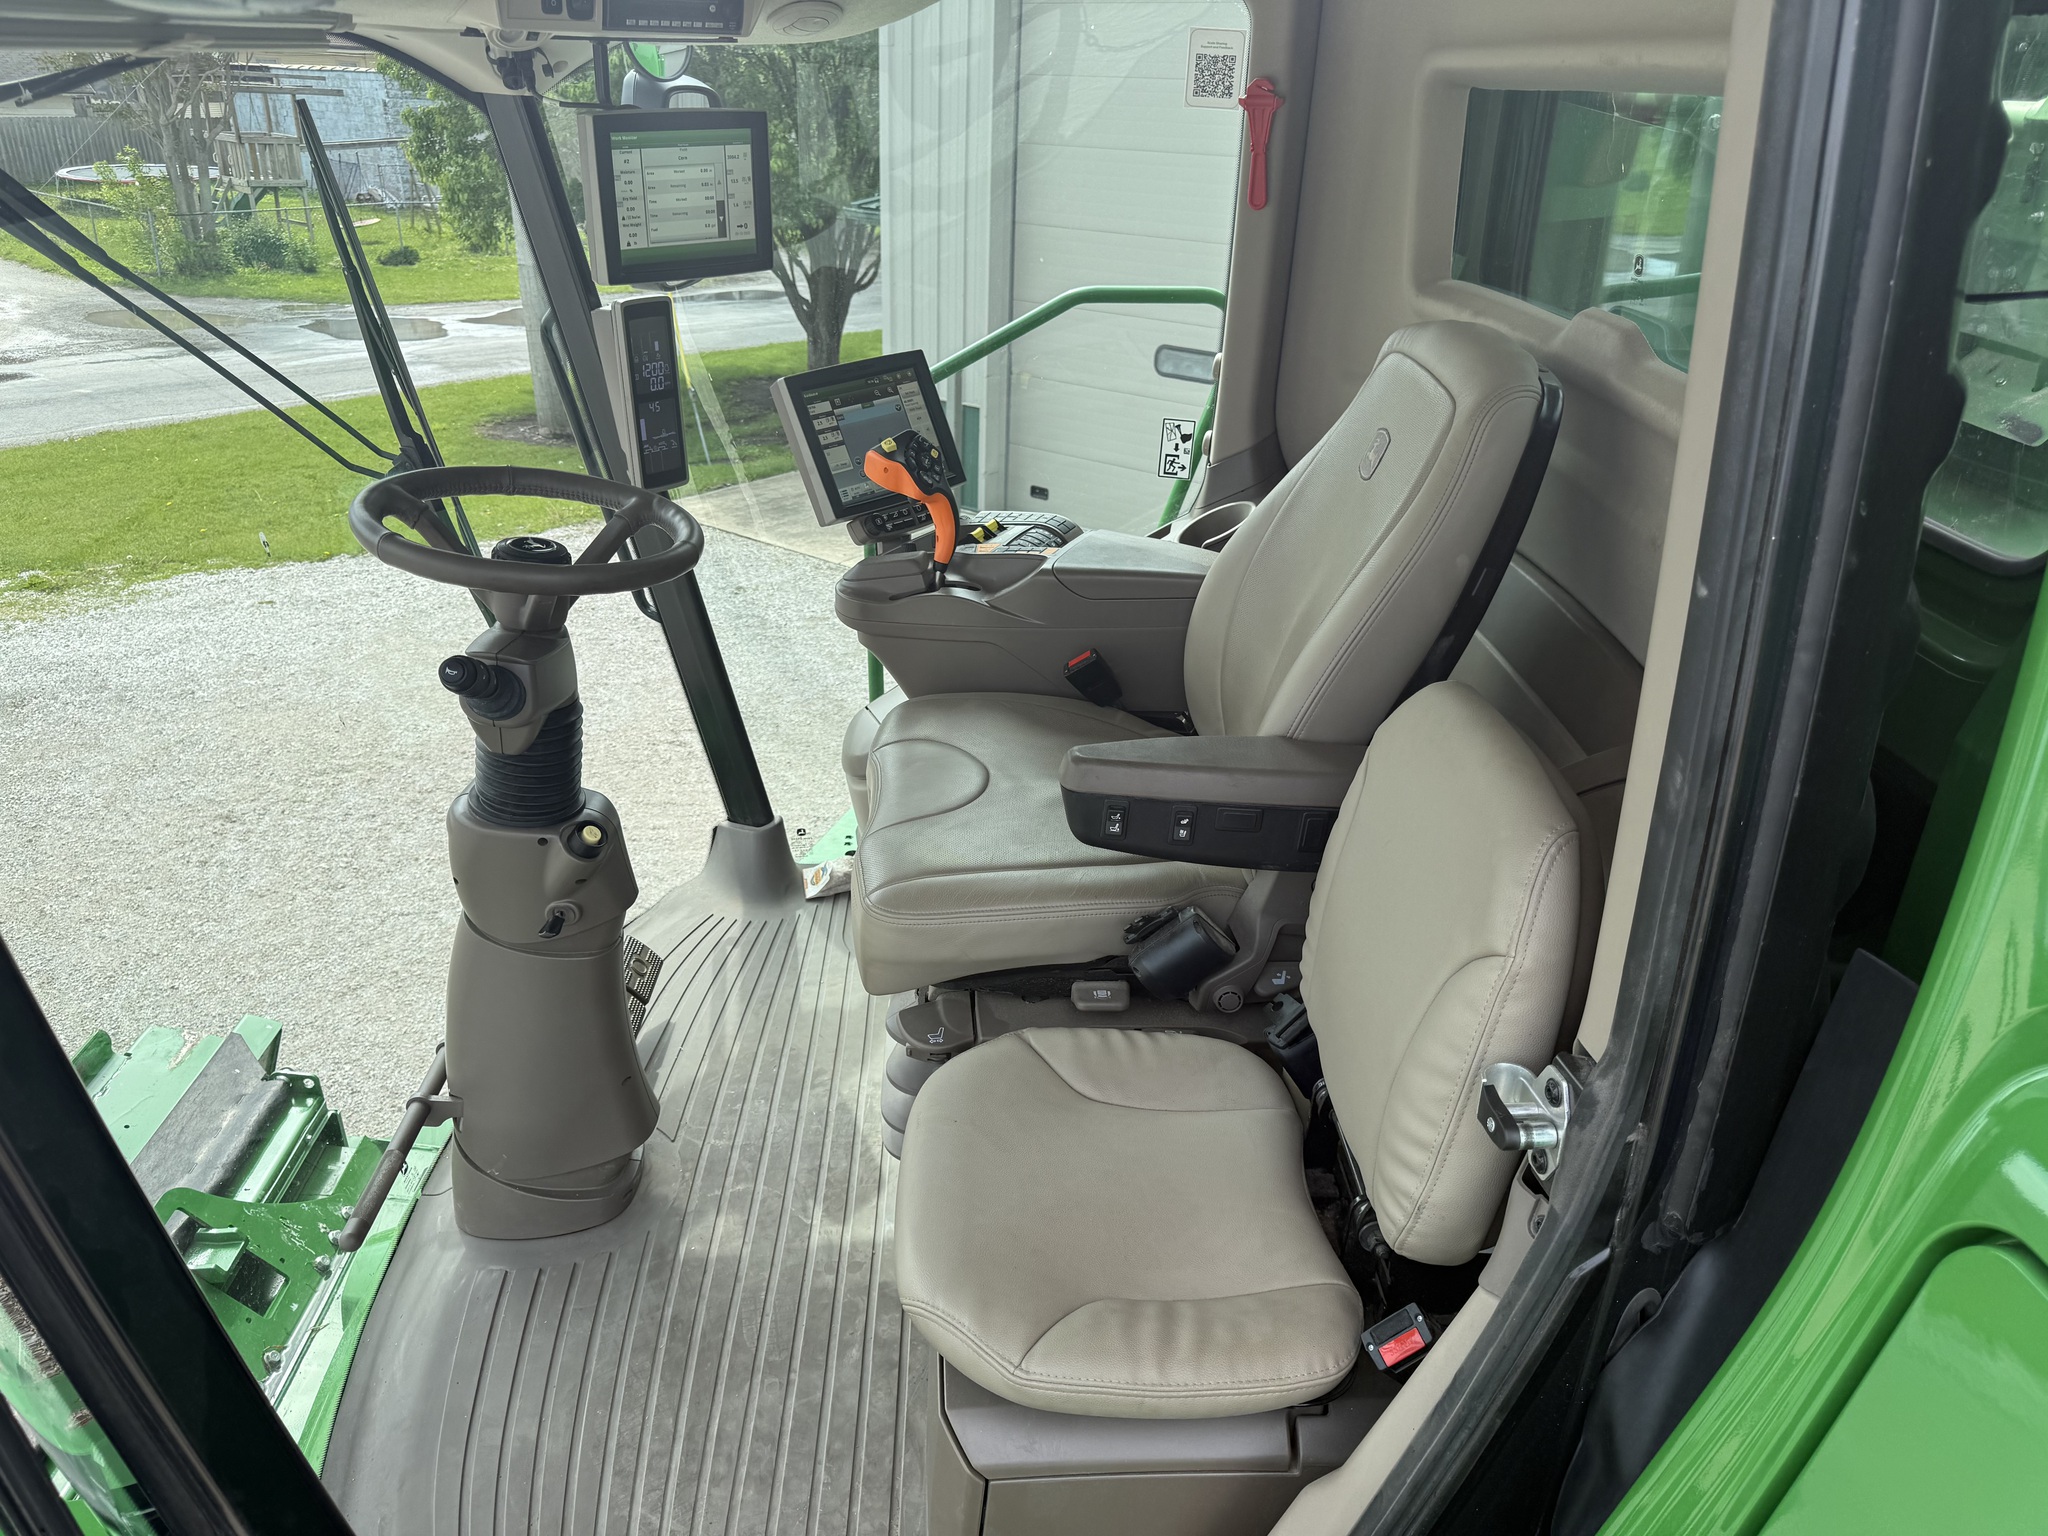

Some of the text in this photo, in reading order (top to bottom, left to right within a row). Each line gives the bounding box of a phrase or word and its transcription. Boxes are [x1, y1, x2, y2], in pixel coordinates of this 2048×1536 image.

[642, 361, 665, 378] 1200
[650, 376, 665, 391] 0.0
[648, 401, 661, 412] 45
